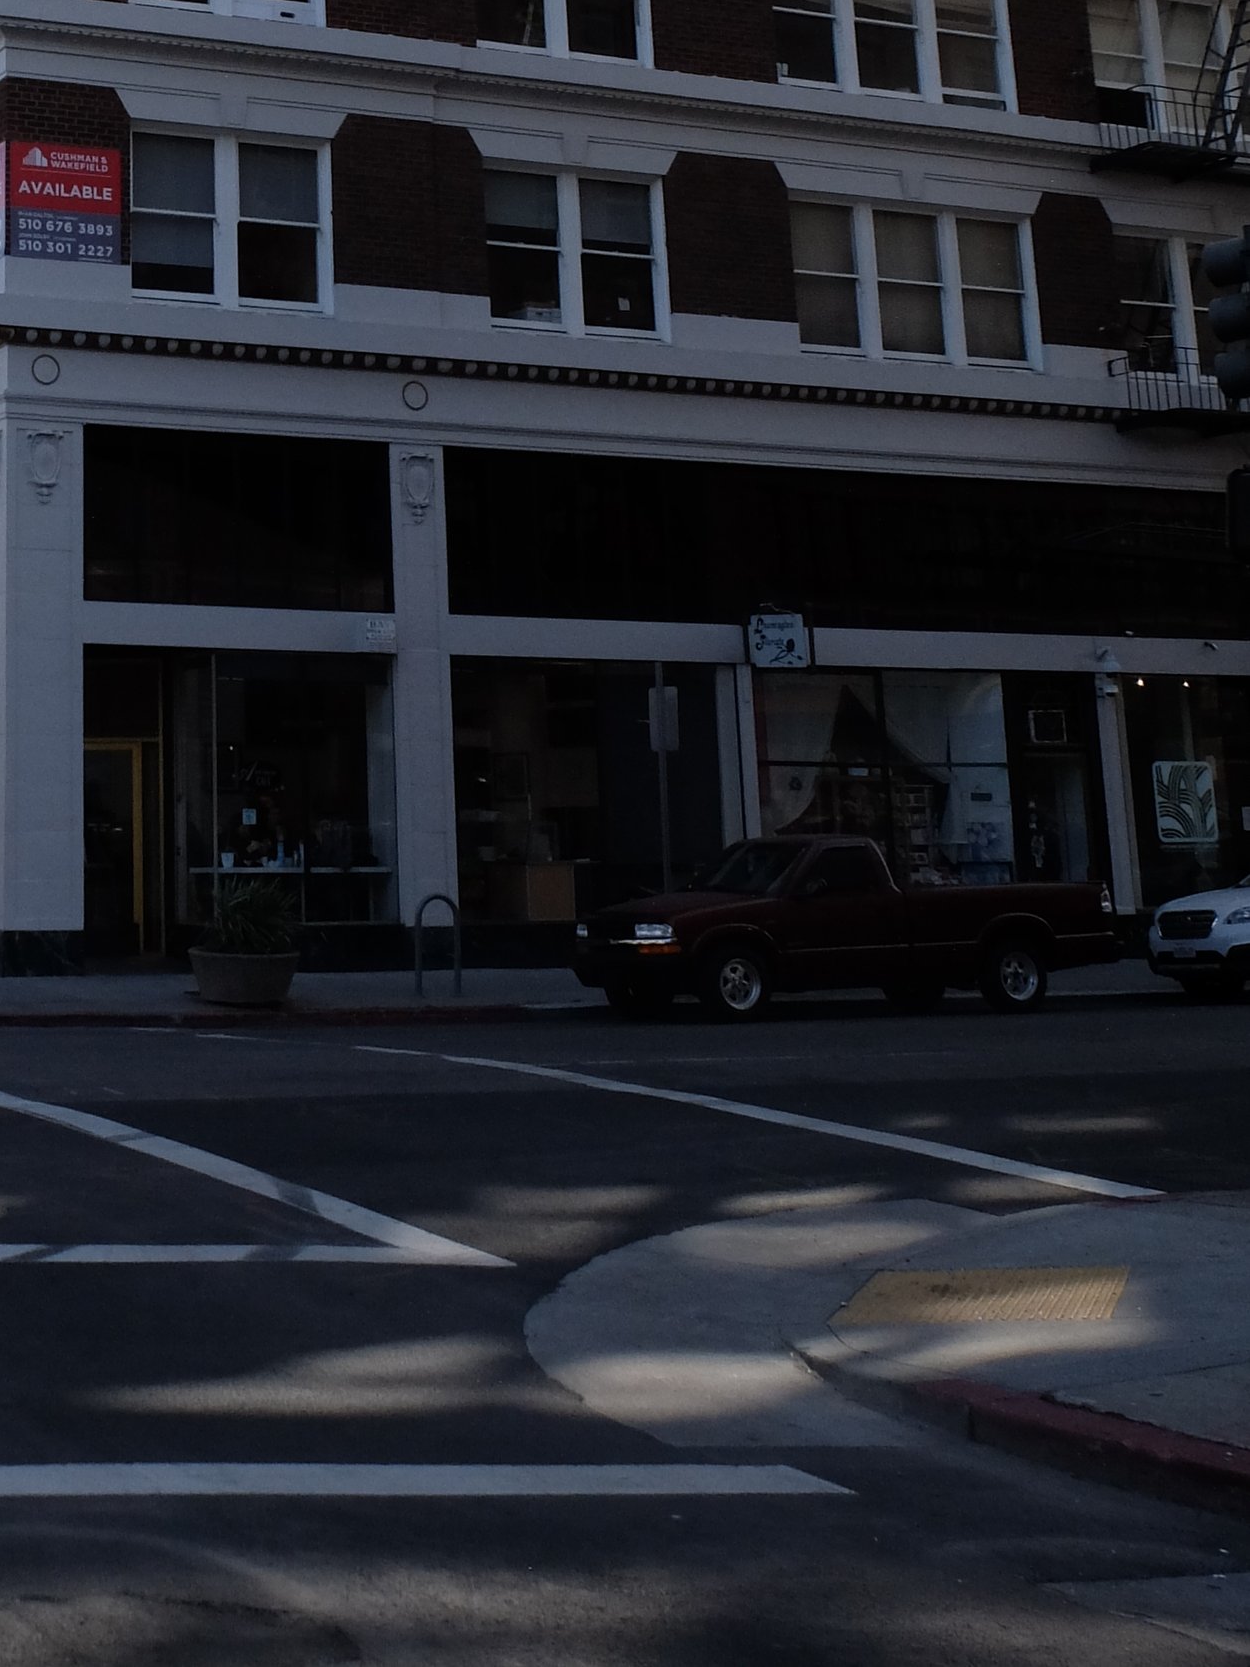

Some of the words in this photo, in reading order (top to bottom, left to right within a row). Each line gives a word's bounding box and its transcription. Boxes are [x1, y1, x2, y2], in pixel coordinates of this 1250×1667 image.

[50, 151, 99, 164] CUSHMAN
[51, 160, 109, 173] WAKEFIELD
[18, 180, 113, 201] AVAILABLE
[18, 218, 43, 230] 510
[46, 220, 73, 233] 676
[78, 223, 113, 237] 3893
[18, 239, 43, 252] 510
[47, 241, 72, 254] 301
[78, 245, 113, 257] 2227
